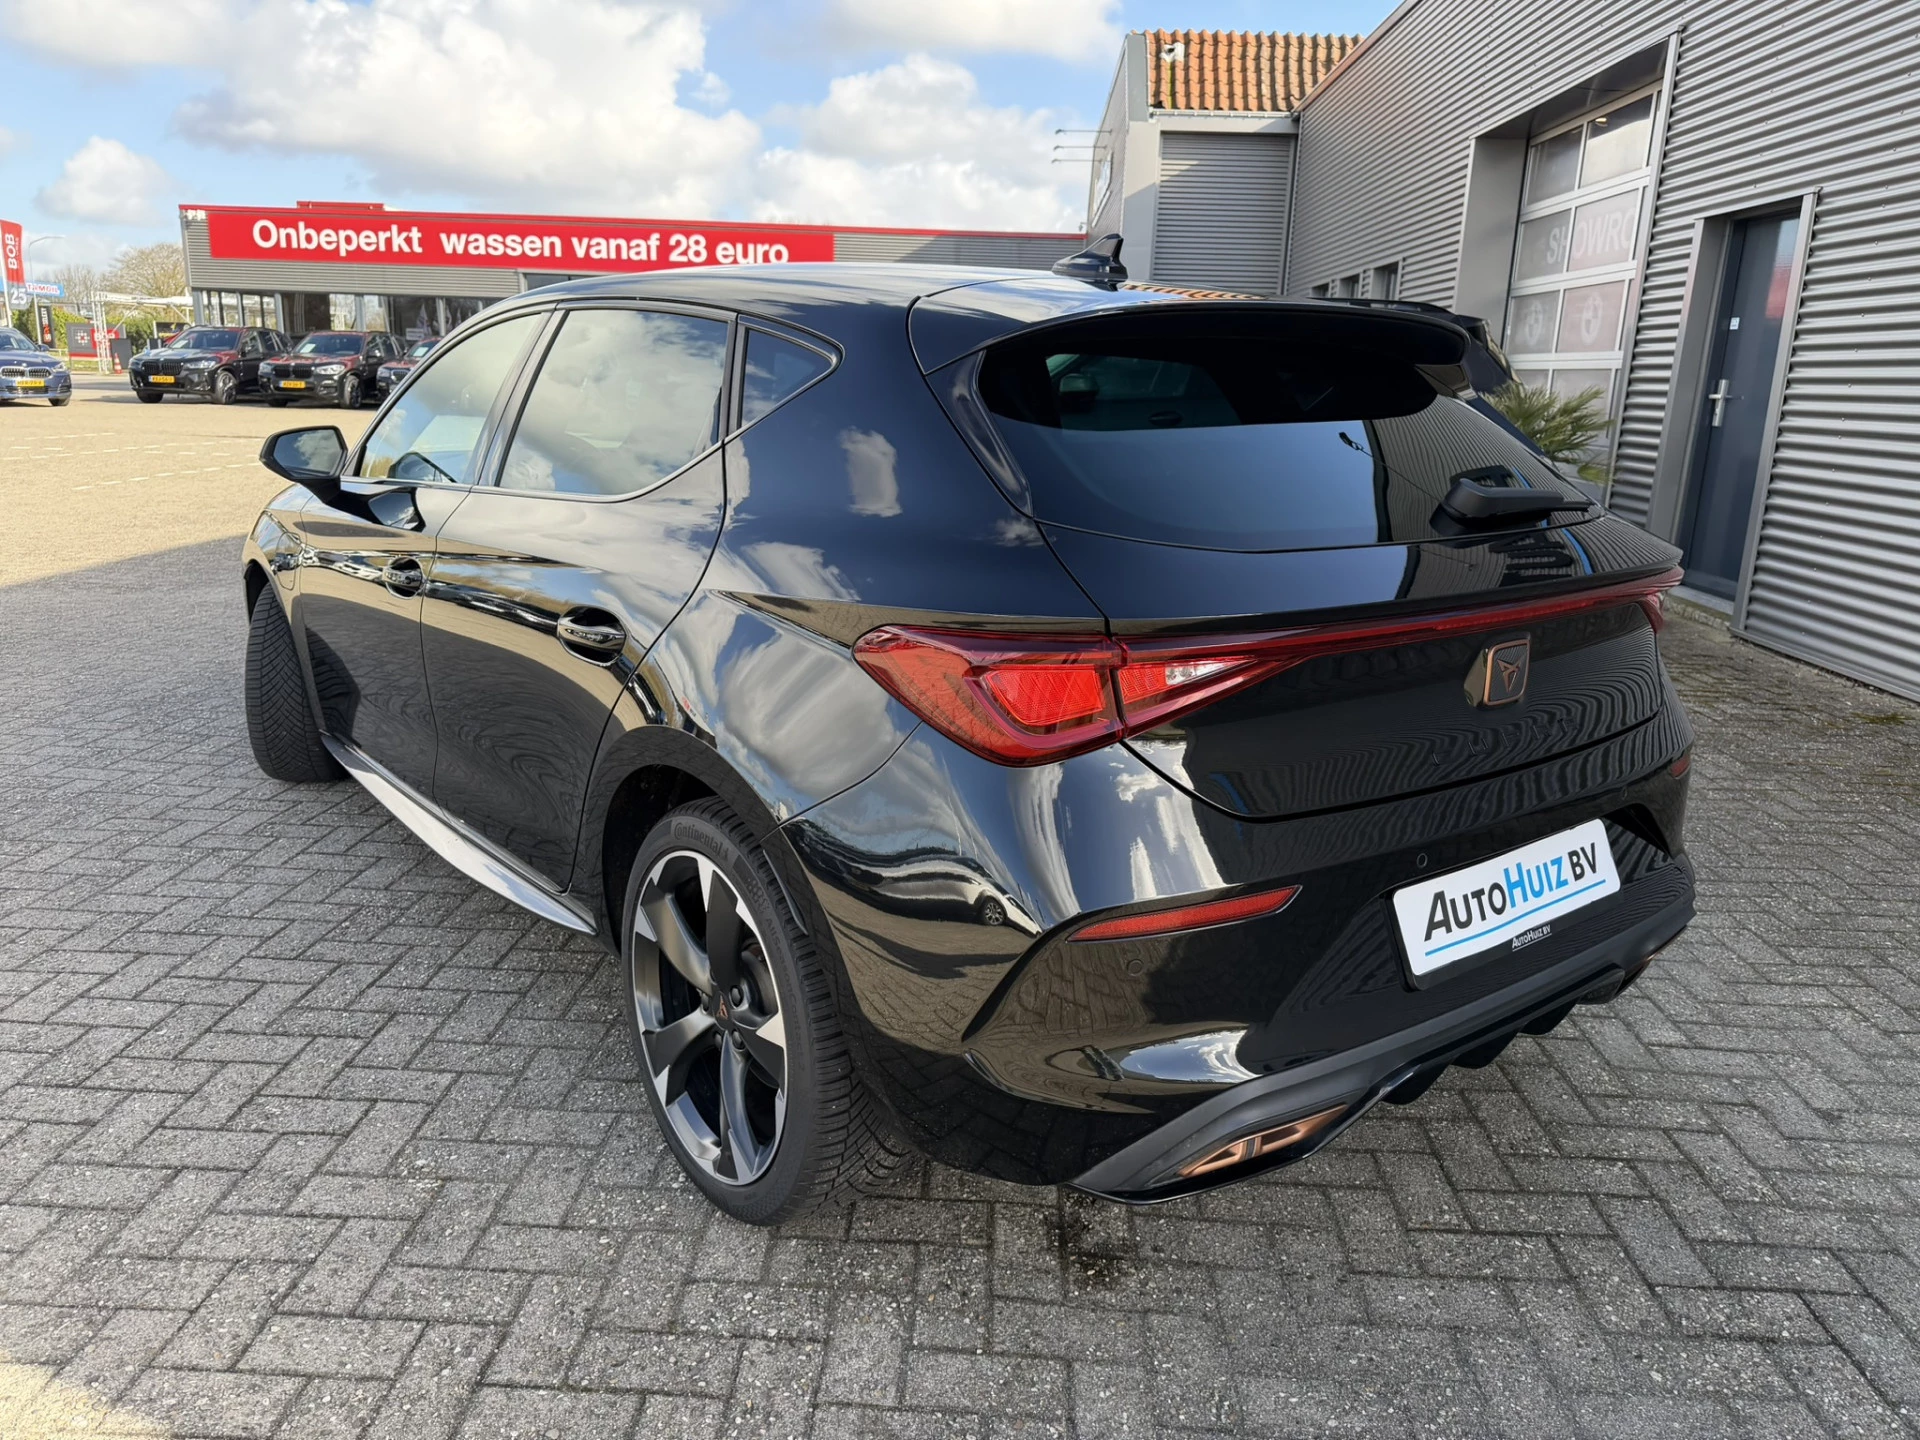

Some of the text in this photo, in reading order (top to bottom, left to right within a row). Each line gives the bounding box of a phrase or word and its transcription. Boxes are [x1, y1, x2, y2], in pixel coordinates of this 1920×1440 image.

[4, 233, 18, 270] BOB
[252, 219, 789, 264] Onbeperkt wassen vanaf 28 euro
[10, 287, 28, 305] 25
[674, 822, 724, 858] Continental
[1567, 842, 1598, 882] BV
[1542, 923, 1551, 935] BV
